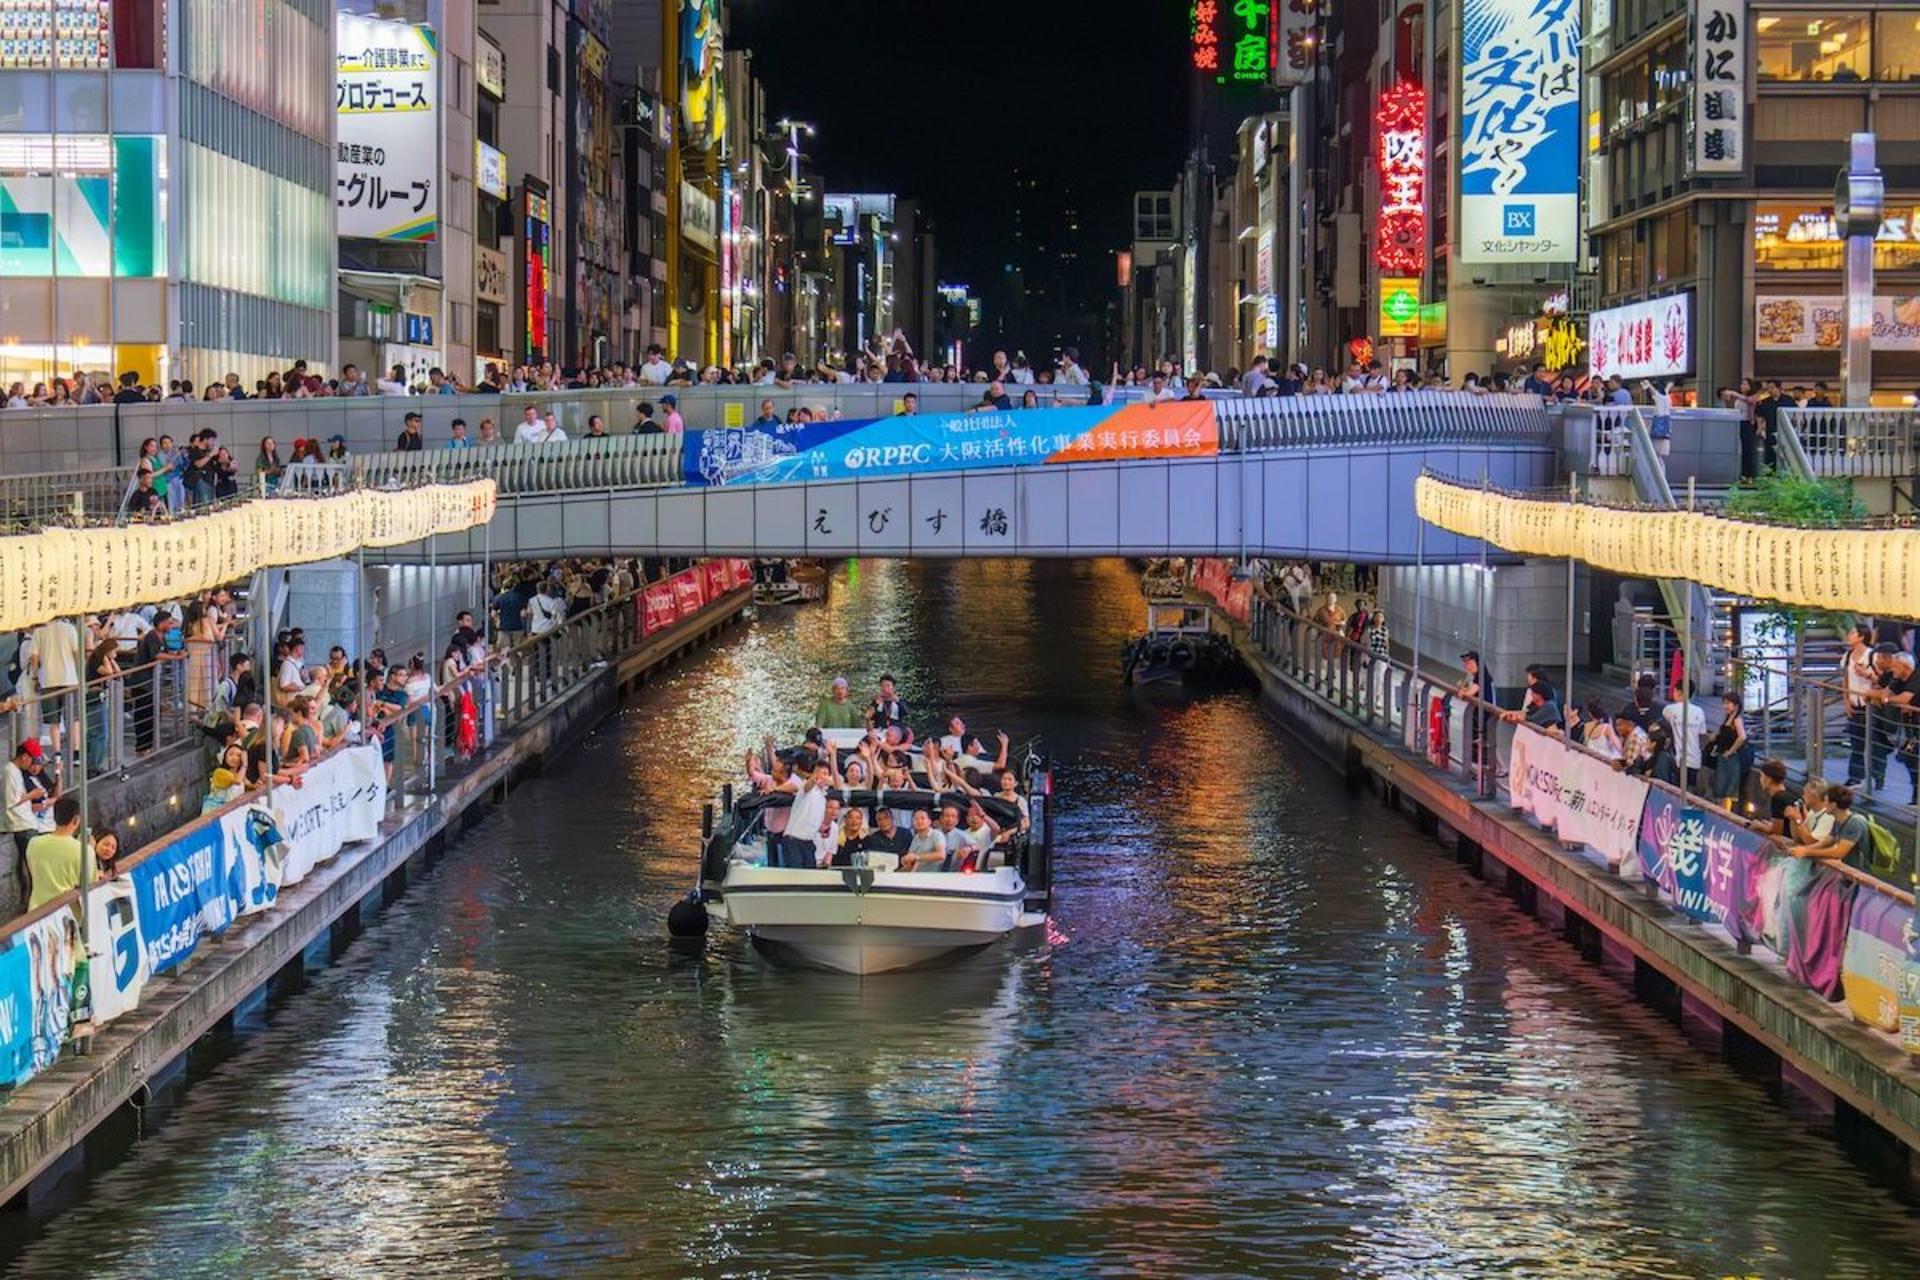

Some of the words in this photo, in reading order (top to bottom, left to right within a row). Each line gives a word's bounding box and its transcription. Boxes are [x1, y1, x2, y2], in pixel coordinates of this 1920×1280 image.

[1507, 211, 1532, 228] BX
[939, 427, 1200, 462] 大阪活性化事業実行委員会
[814, 508, 1008, 536] えびす橋
